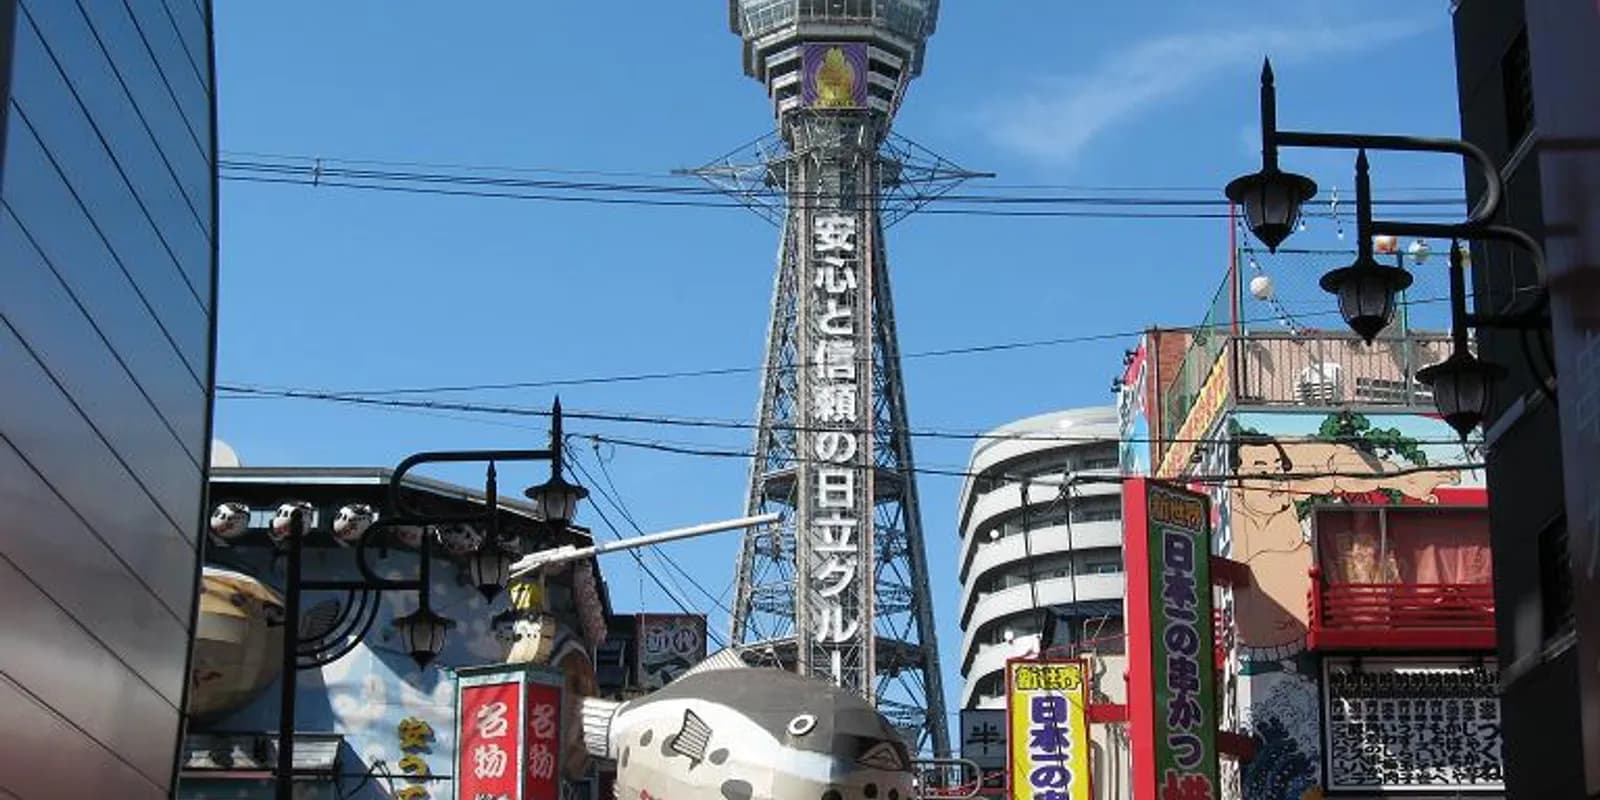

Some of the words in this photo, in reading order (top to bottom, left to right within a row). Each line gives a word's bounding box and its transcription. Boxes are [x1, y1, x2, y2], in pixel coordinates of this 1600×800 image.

[1016, 665, 1081, 690] 新世界
[473, 701, 509, 780] 名物
